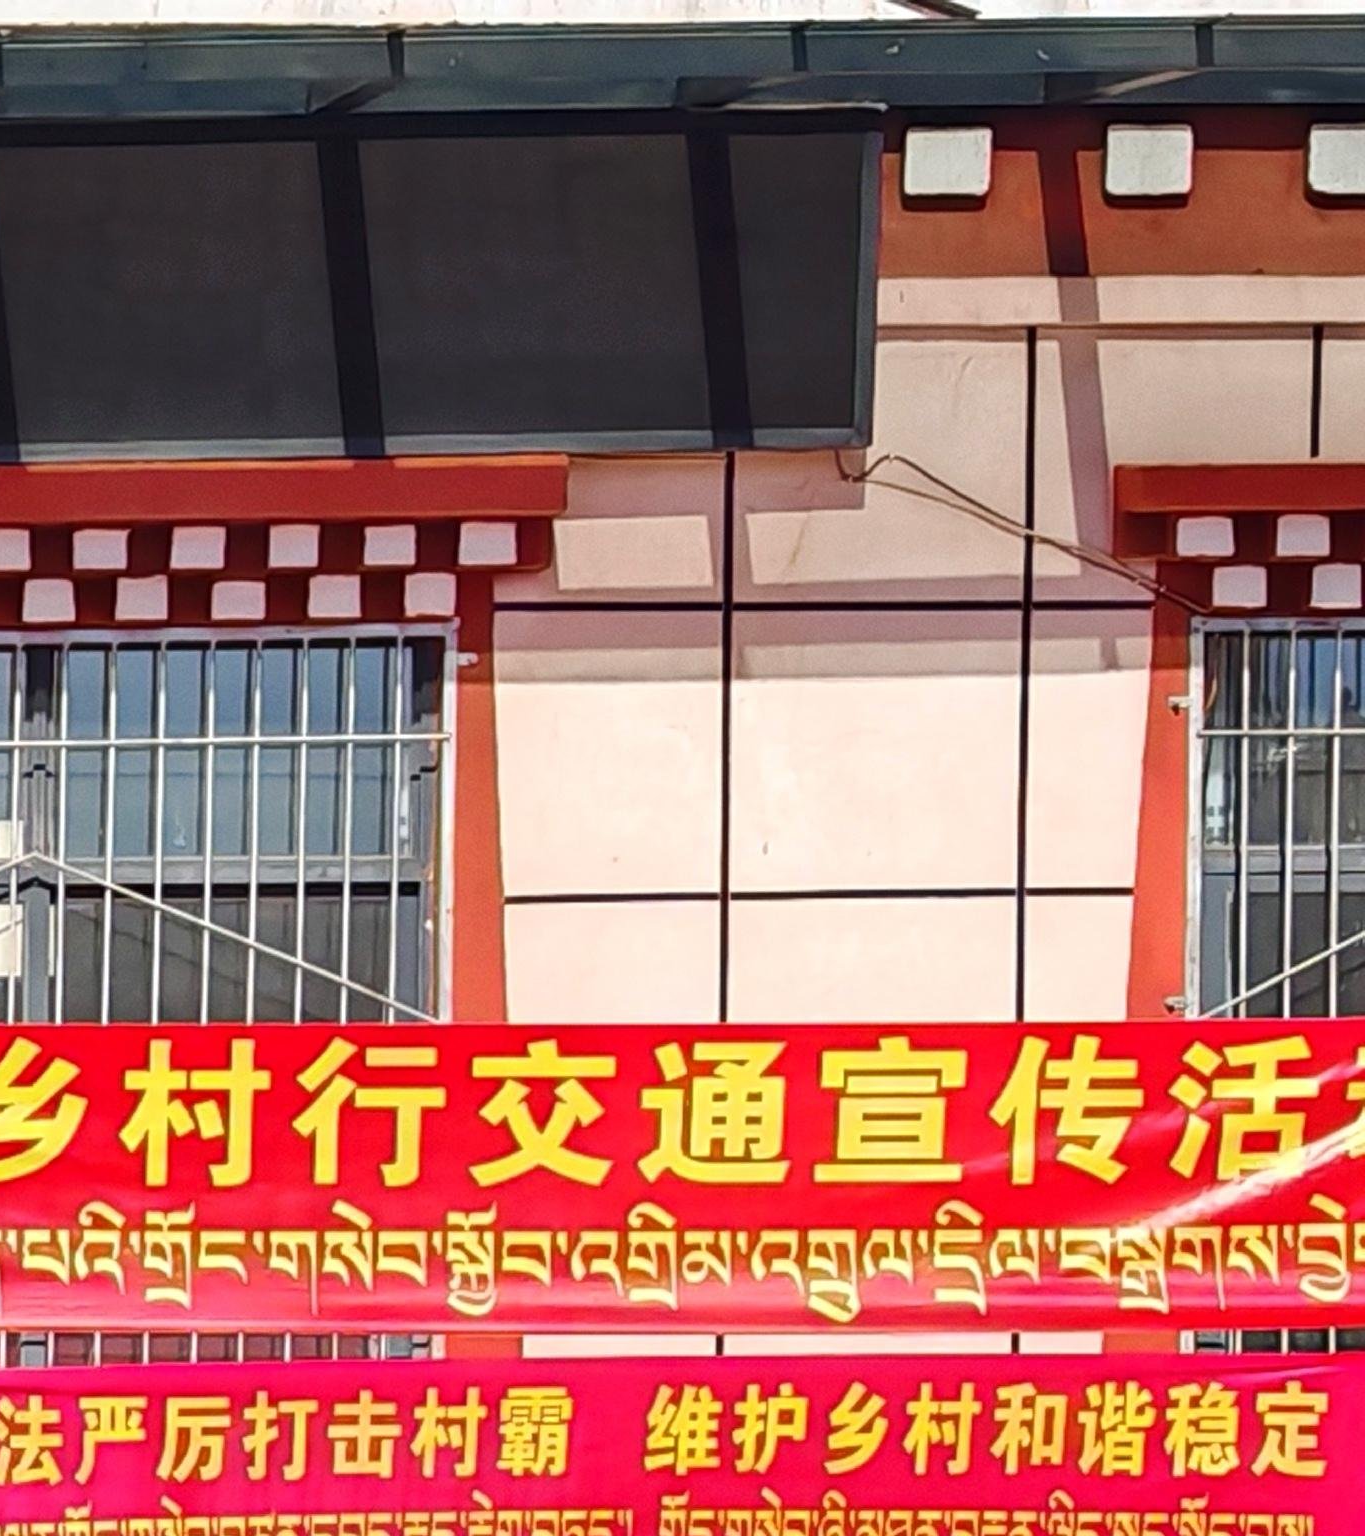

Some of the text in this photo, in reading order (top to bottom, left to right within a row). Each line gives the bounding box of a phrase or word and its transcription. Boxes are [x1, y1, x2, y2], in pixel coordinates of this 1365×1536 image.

[644, 1381, 1331, 1479] 维护乡村和谐稳定
